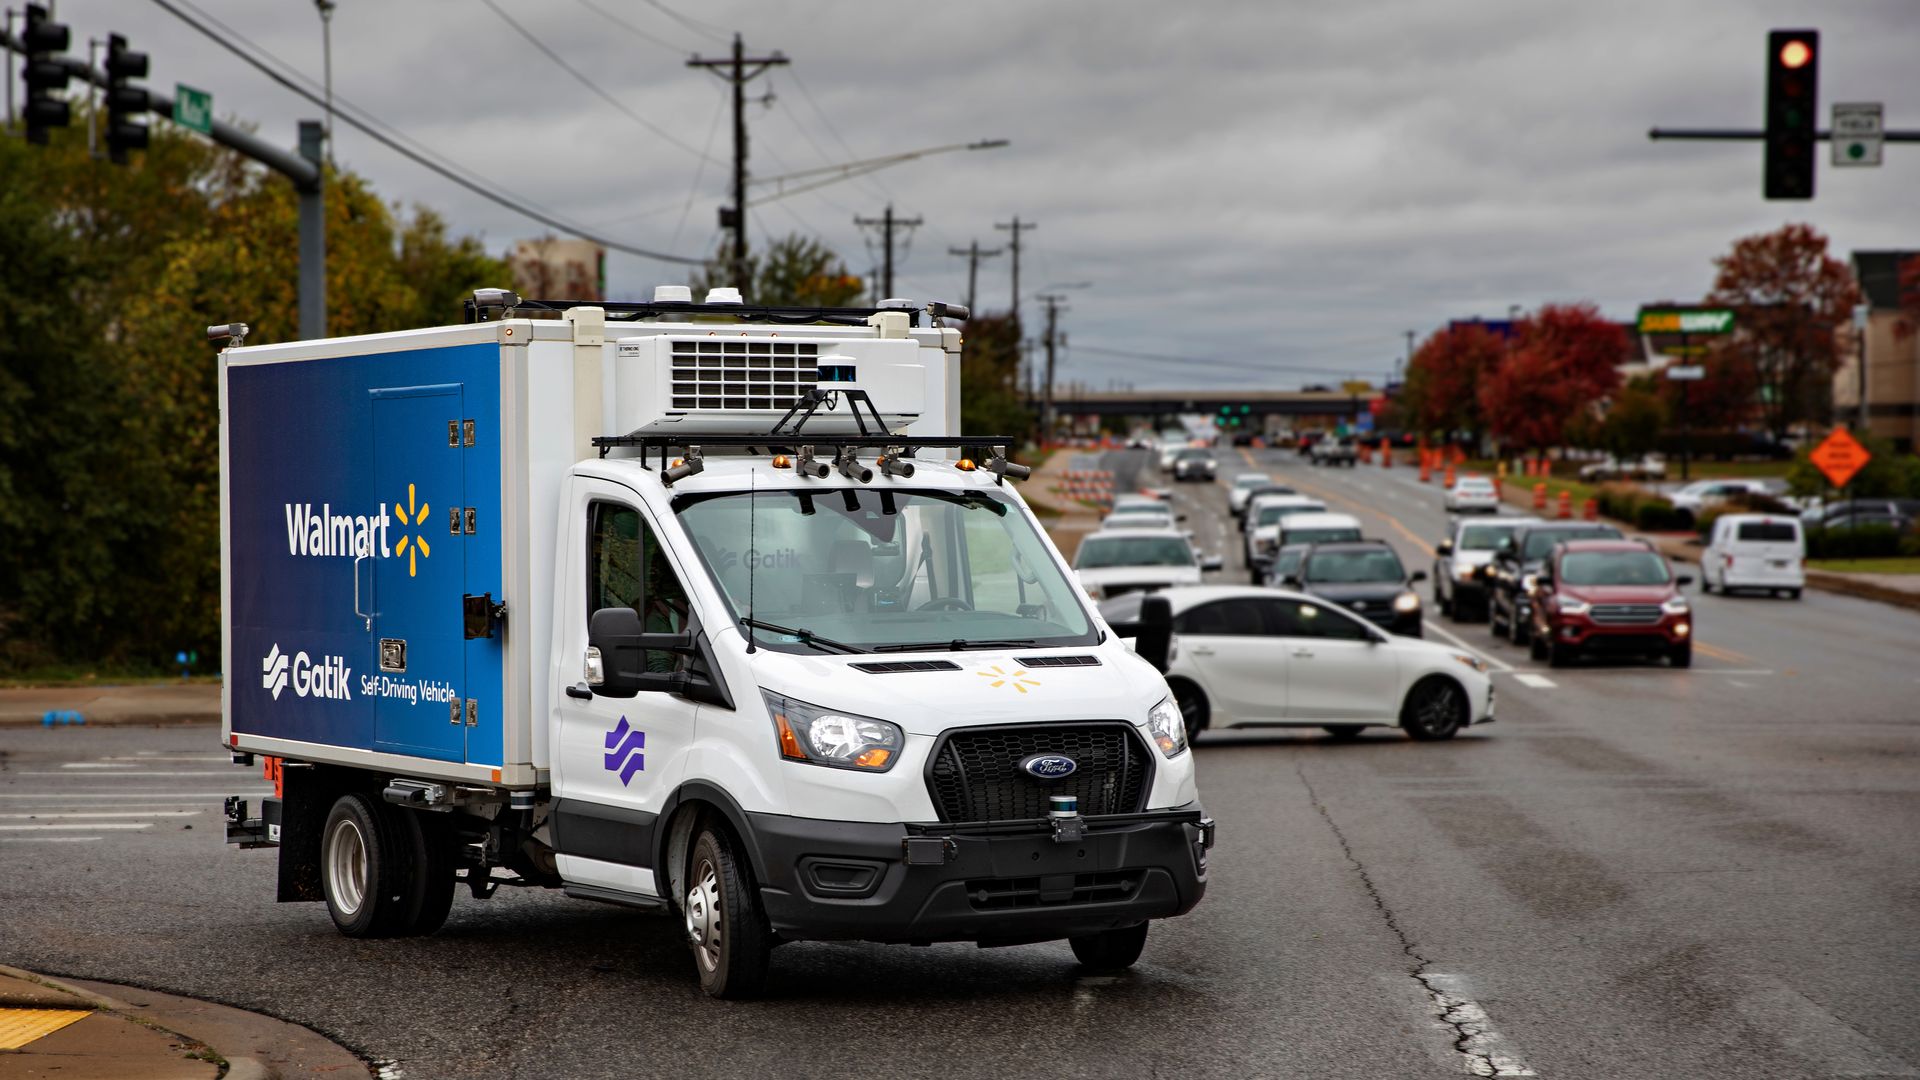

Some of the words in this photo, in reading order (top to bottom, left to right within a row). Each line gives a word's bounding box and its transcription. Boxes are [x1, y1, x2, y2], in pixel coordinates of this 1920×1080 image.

[285, 503, 390, 558] Walmart
[743, 548, 801, 570] Gatik
[293, 651, 351, 701] Gatik
[361, 674, 417, 705] Self-Driving
[419, 679, 455, 703] Vehicle
[1040, 759, 1067, 773] Ford
